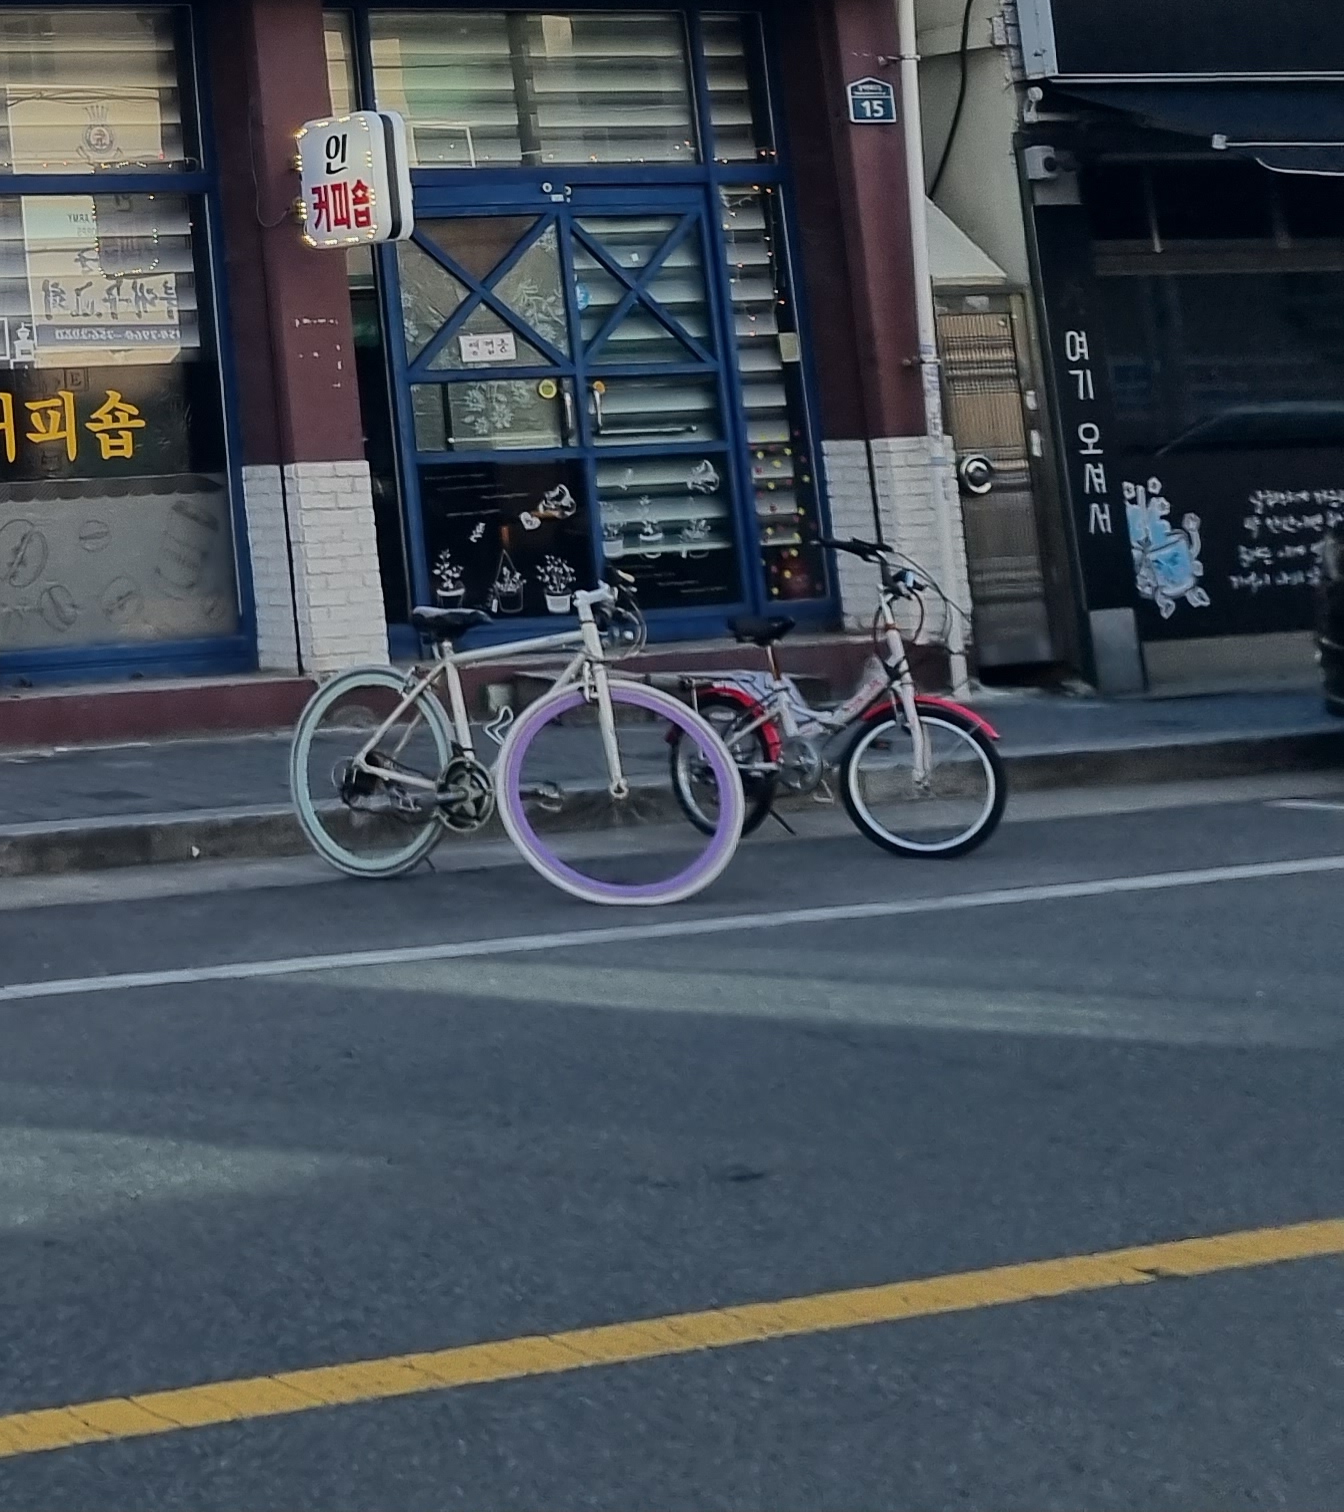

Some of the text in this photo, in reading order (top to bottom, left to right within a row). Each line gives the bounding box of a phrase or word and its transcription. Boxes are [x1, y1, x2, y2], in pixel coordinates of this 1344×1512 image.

[861, 99, 884, 118] 15
[324, 133, 349, 175] 인
[311, 179, 372, 233] 커피숍
[1065, 330, 1095, 401] 여기
